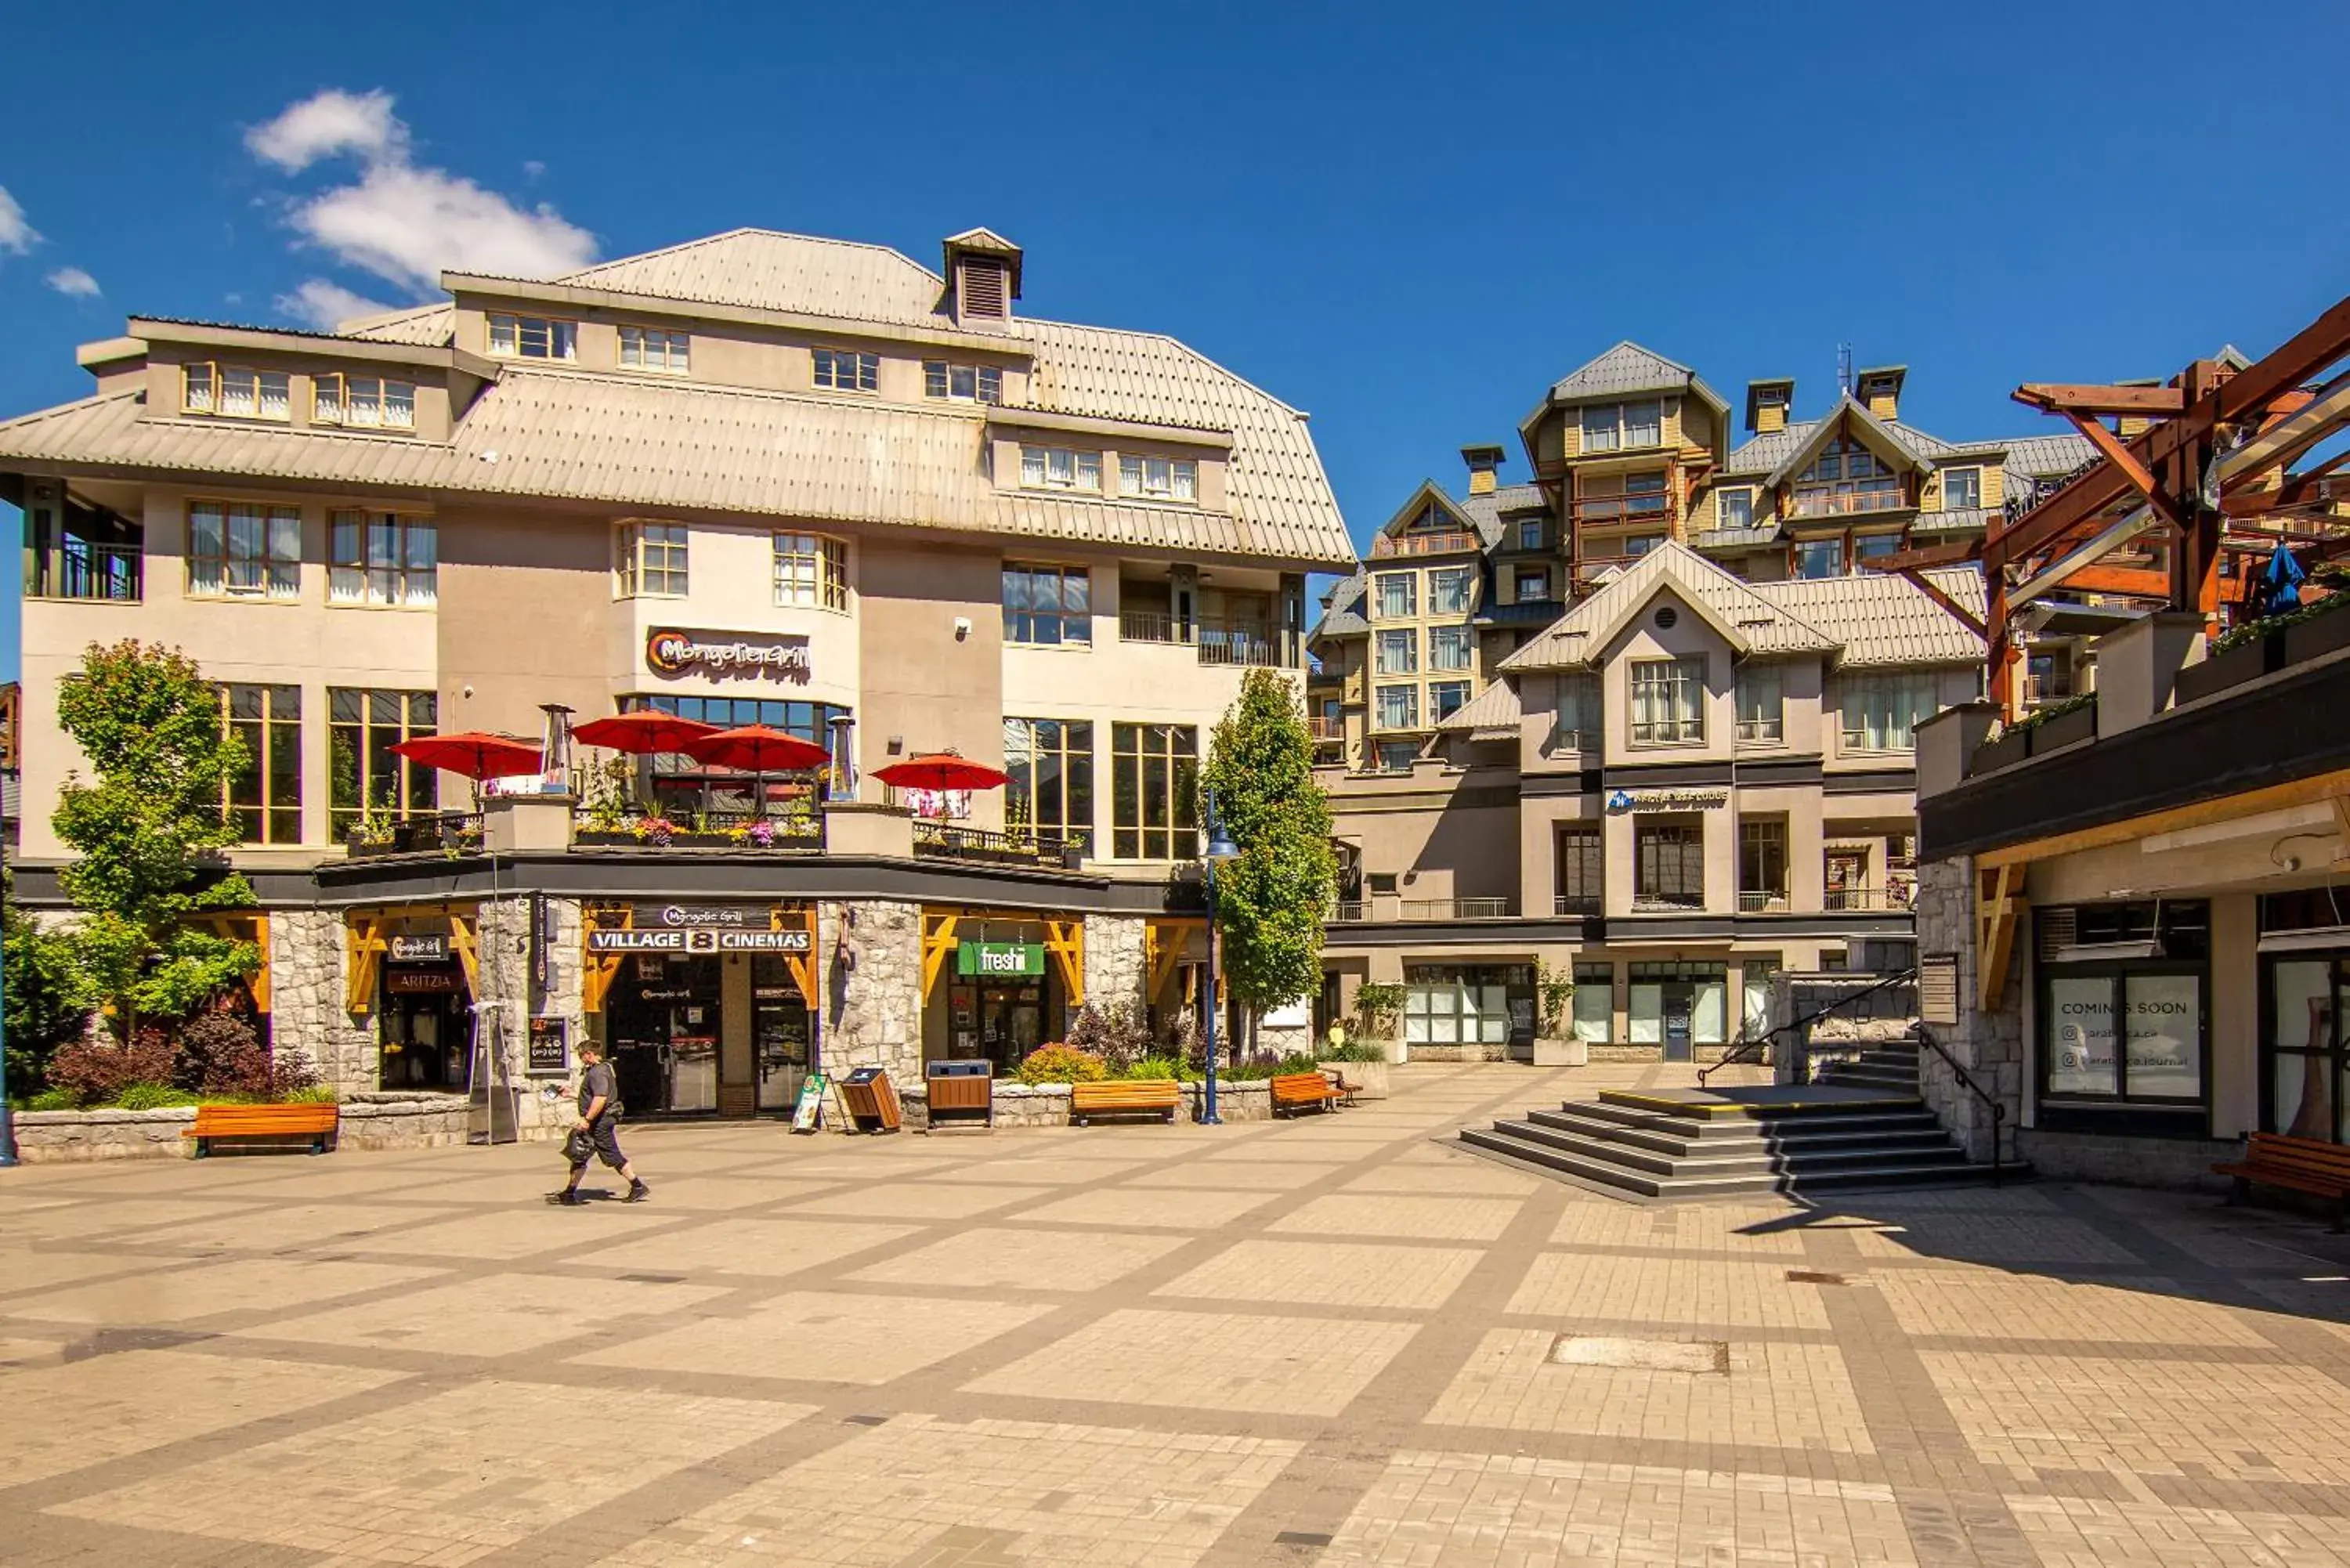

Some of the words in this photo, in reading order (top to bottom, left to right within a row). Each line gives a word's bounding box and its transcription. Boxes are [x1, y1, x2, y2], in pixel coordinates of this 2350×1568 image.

[763, 645, 811, 667] Grill
[595, 933, 681, 947] VILLAGE
[692, 933, 714, 949] 8
[721, 934, 808, 948] CINEMAS
[401, 974, 450, 988] ARITZIA
[2137, 1002, 2187, 1014] SOON
